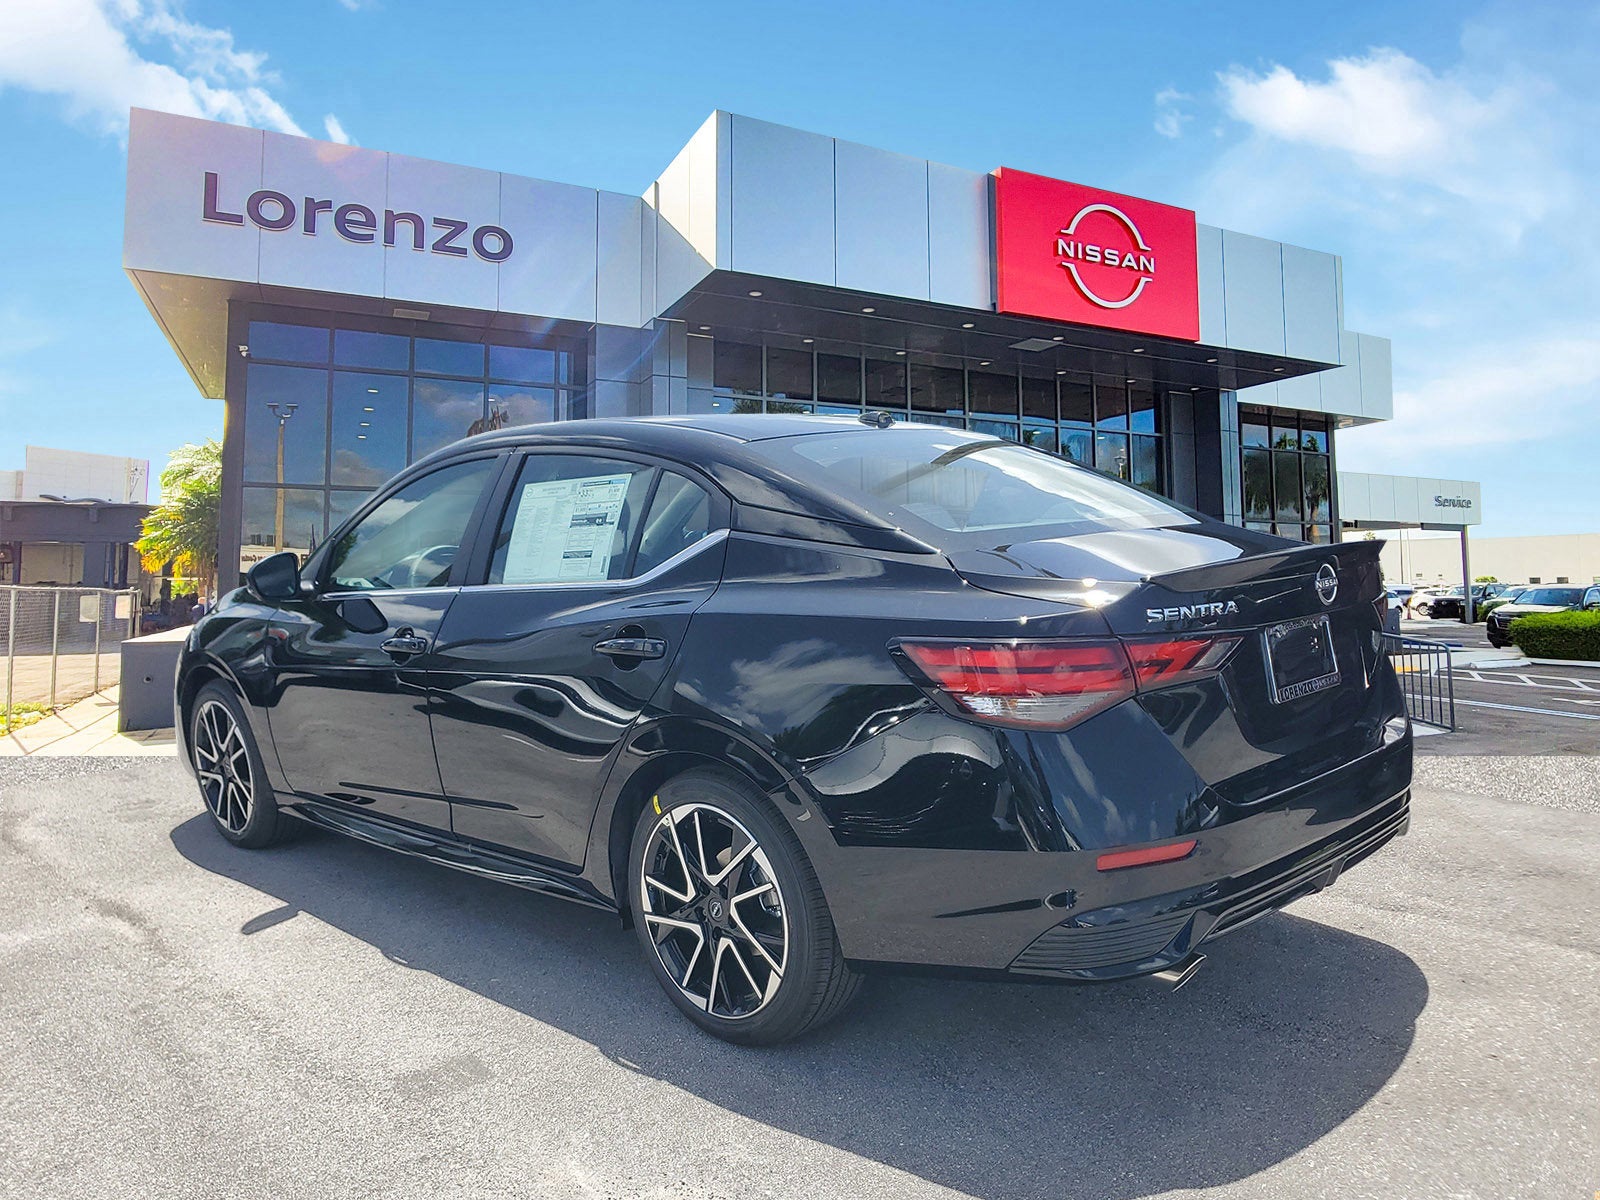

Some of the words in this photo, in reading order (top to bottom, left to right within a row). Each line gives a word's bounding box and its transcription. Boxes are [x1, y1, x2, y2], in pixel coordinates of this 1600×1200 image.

[202, 171, 514, 262] Lorenzo
[1057, 238, 1155, 273] NISSAN
[1434, 495, 1472, 508] Service
[1146, 601, 1239, 622] SENTRA
